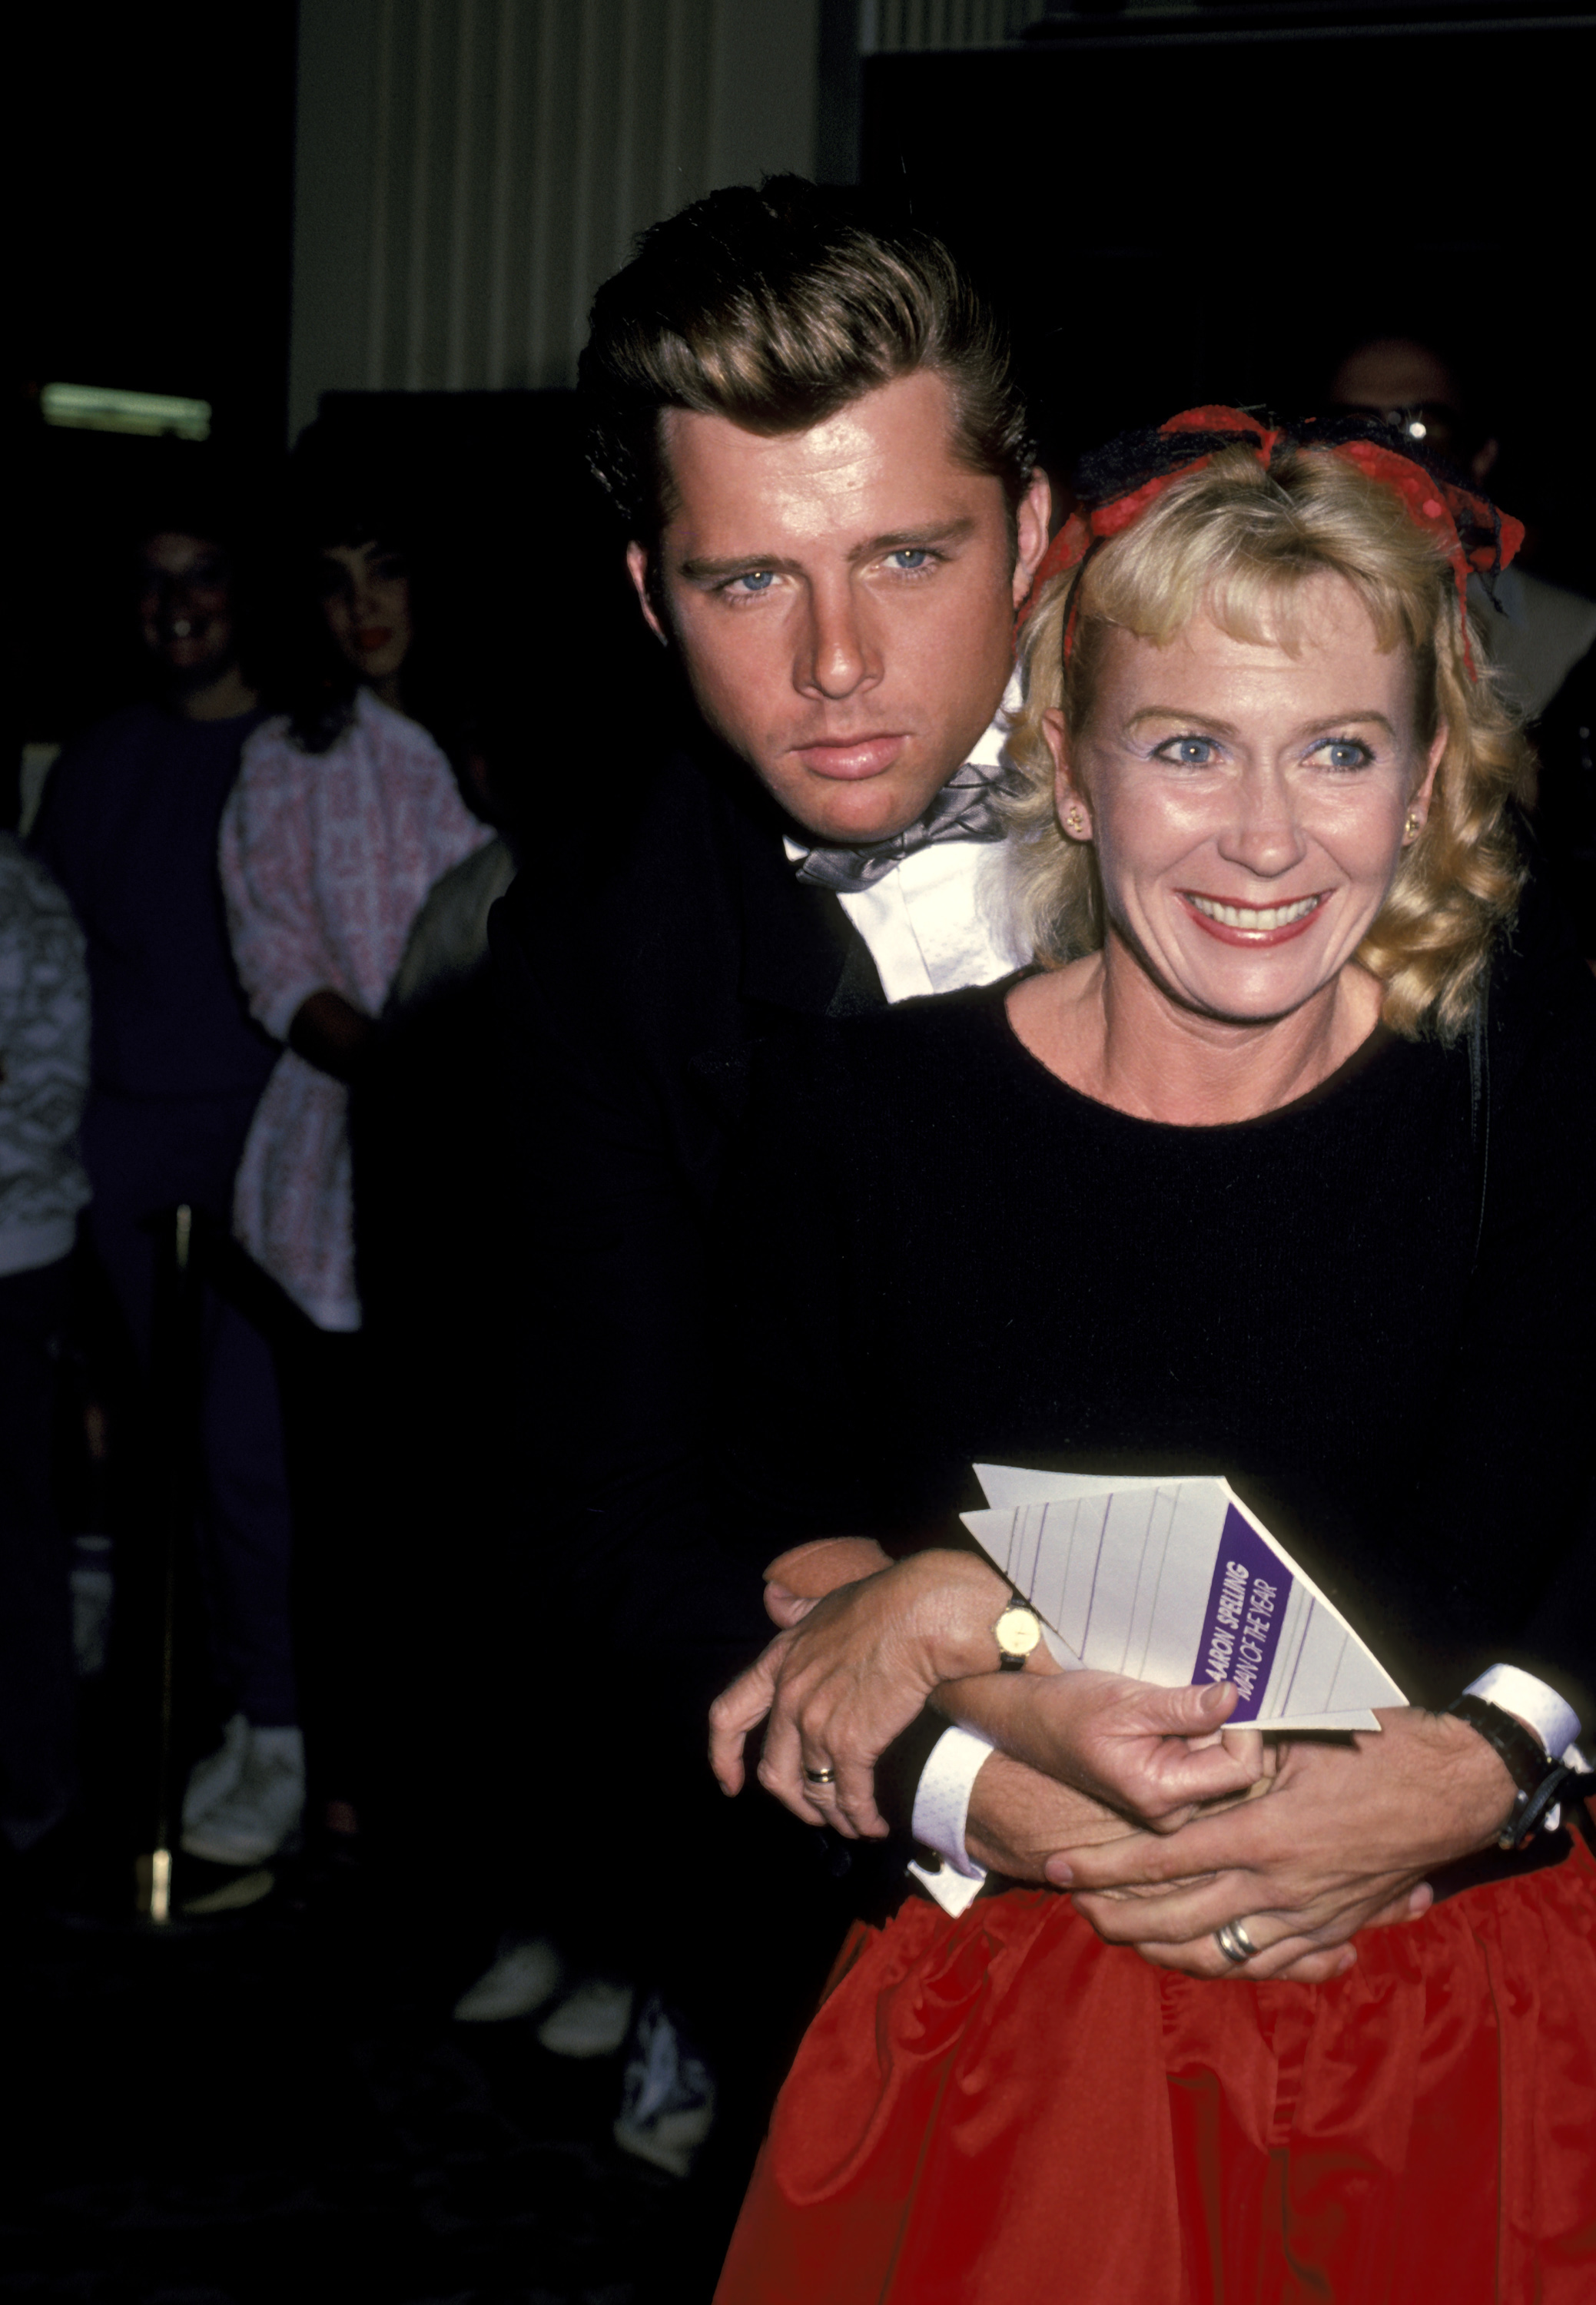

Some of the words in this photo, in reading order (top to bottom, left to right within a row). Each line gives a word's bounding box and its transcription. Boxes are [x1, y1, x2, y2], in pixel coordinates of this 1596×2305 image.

[1217, 1560, 1249, 1630] SPELLING
[1249, 1577, 1277, 1618] YEAR
[1243, 1612, 1270, 1643] THE
[1205, 1627, 1236, 1682] AARON
[1239, 1636, 1263, 1663] OF
[1233, 1657, 1259, 1701] MAN
